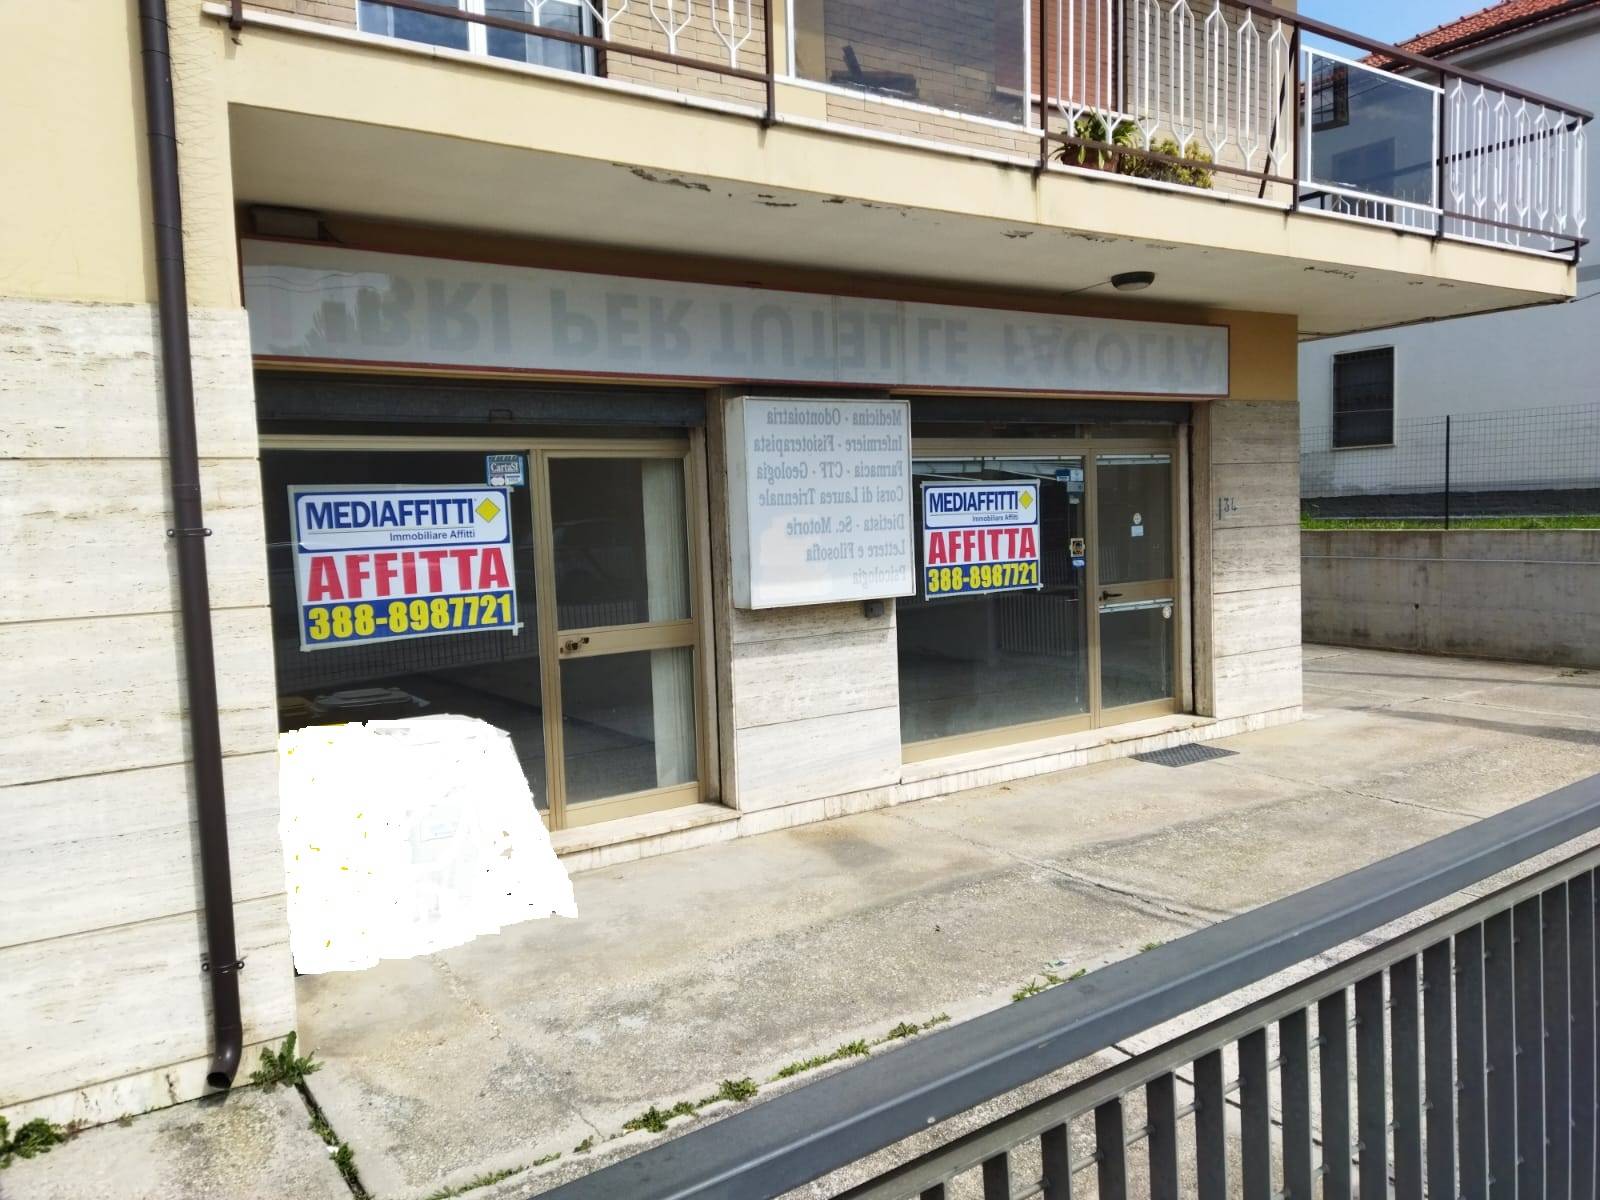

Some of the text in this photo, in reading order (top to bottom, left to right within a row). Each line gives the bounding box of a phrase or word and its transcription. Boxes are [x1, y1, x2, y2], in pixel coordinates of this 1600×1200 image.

[305, 498, 474, 530] MEDIAFFITTI
[929, 491, 1018, 513] MEDIAFFITTI
[389, 529, 475, 542] Immobiliare Affitti
[928, 527, 1036, 565] AFFITTA
[307, 547, 510, 602] AFFITTA
[928, 562, 1037, 593] 388-8987721
[308, 593, 511, 640] 388-8987721
